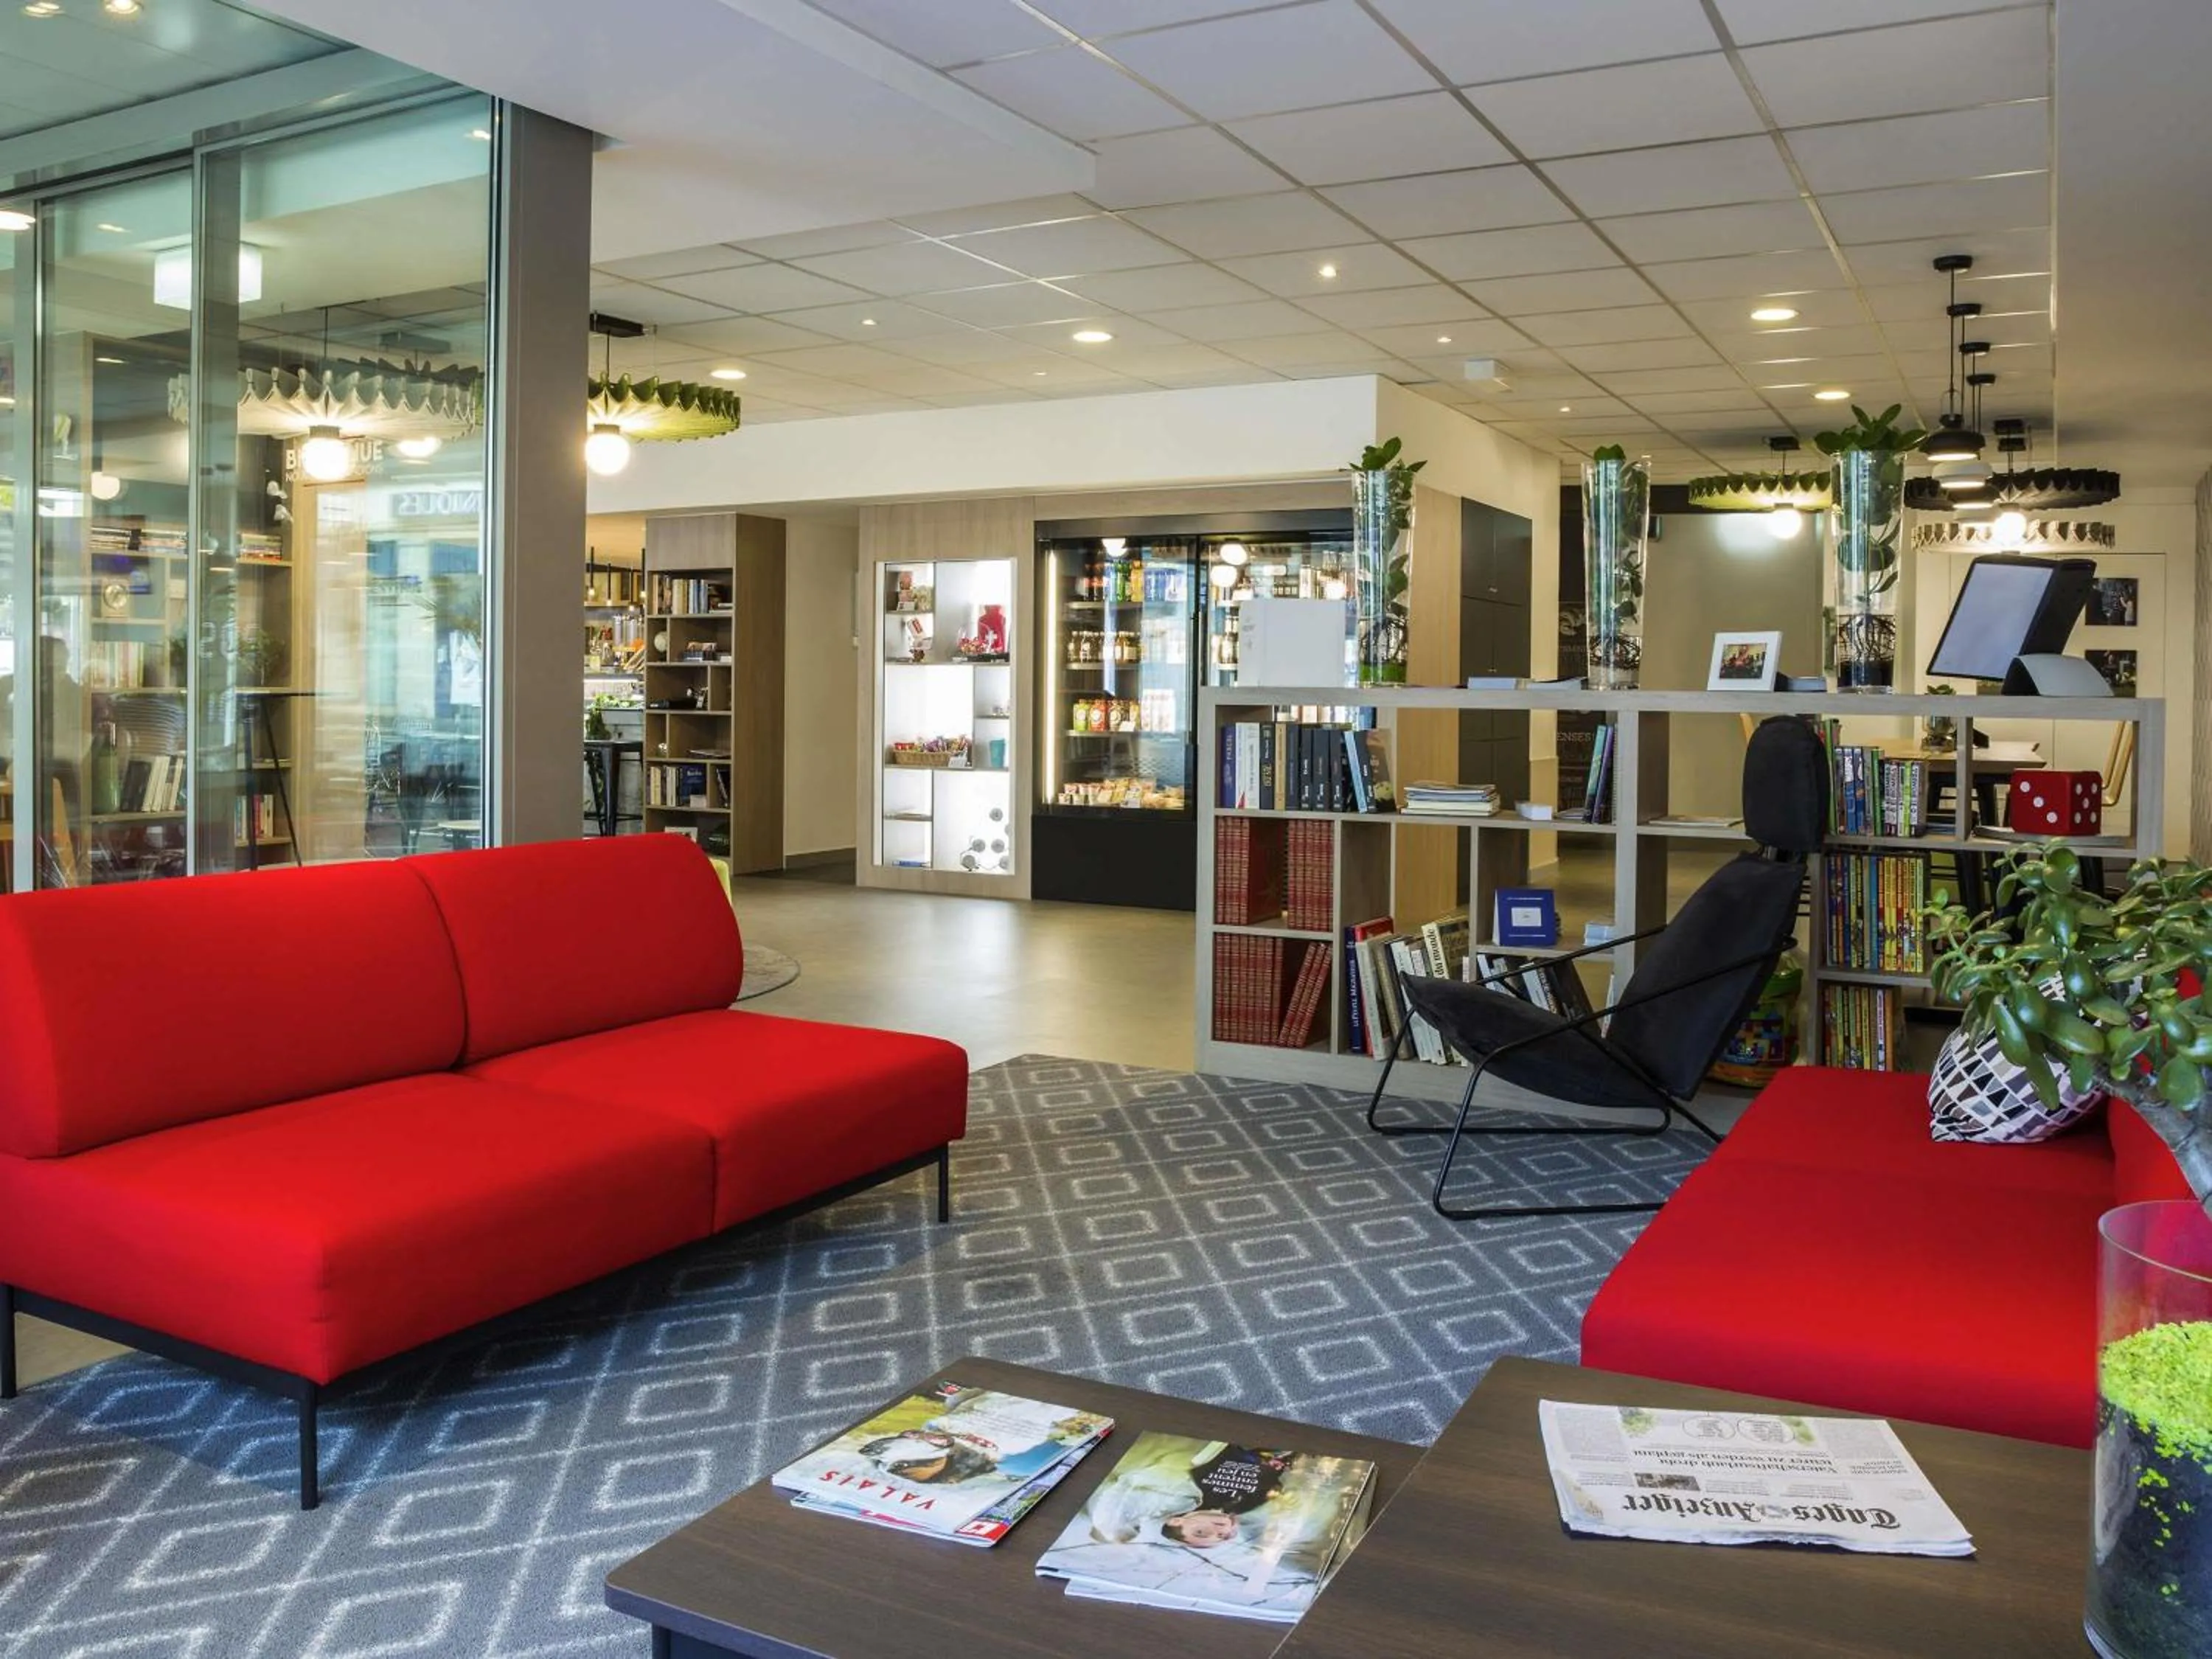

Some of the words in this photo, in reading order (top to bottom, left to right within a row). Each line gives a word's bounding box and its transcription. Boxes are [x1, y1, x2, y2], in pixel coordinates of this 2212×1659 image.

[1208, 1472, 1259, 1484] entrent
[1217, 1467, 1239, 1476] jeu
[818, 1470, 936, 1510] VALAIS
[1201, 1478, 1256, 1493] femmes
[1212, 1486, 1237, 1498] Les
[1622, 1493, 1761, 1523] Anzeiger
[1791, 1503, 1901, 1529] Tages
